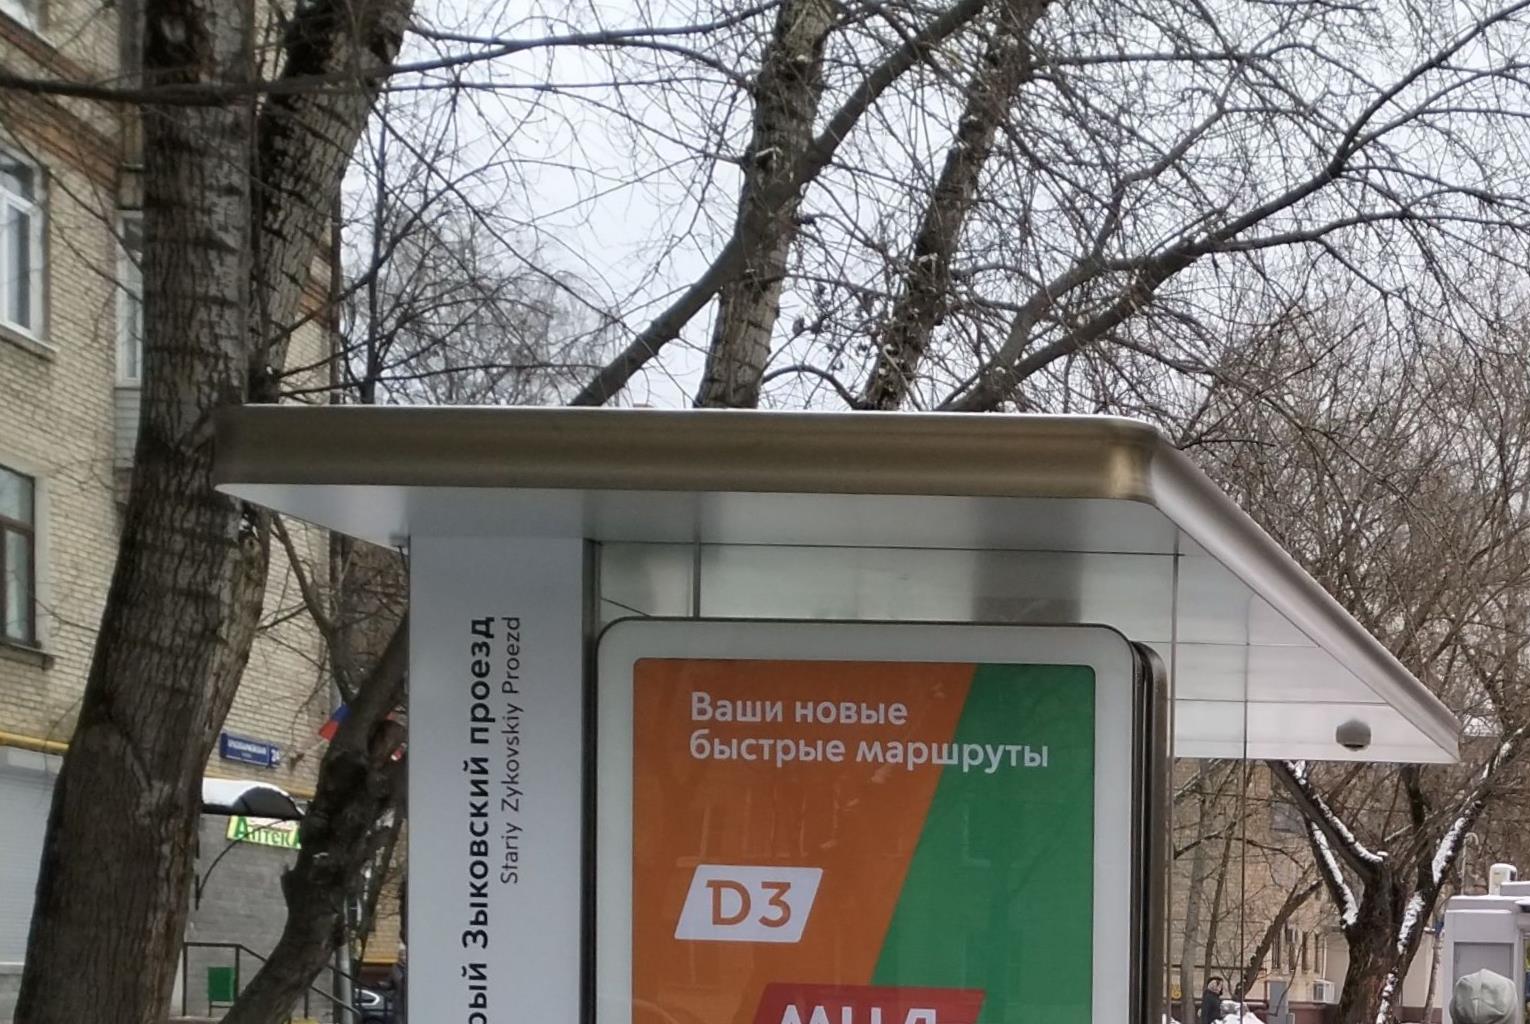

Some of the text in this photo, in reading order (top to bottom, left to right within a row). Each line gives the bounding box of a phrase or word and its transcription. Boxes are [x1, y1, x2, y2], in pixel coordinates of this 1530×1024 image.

[470, 617, 496, 744] проезд
[691, 691, 908, 726] Ваши новые
[500, 617, 524, 884] Stariy Zykovskiy Proezd
[689, 729, 1049, 774] быстрые маршруты
[461, 757, 489, 949] Зыковский
[705, 879, 792, 928] D3
